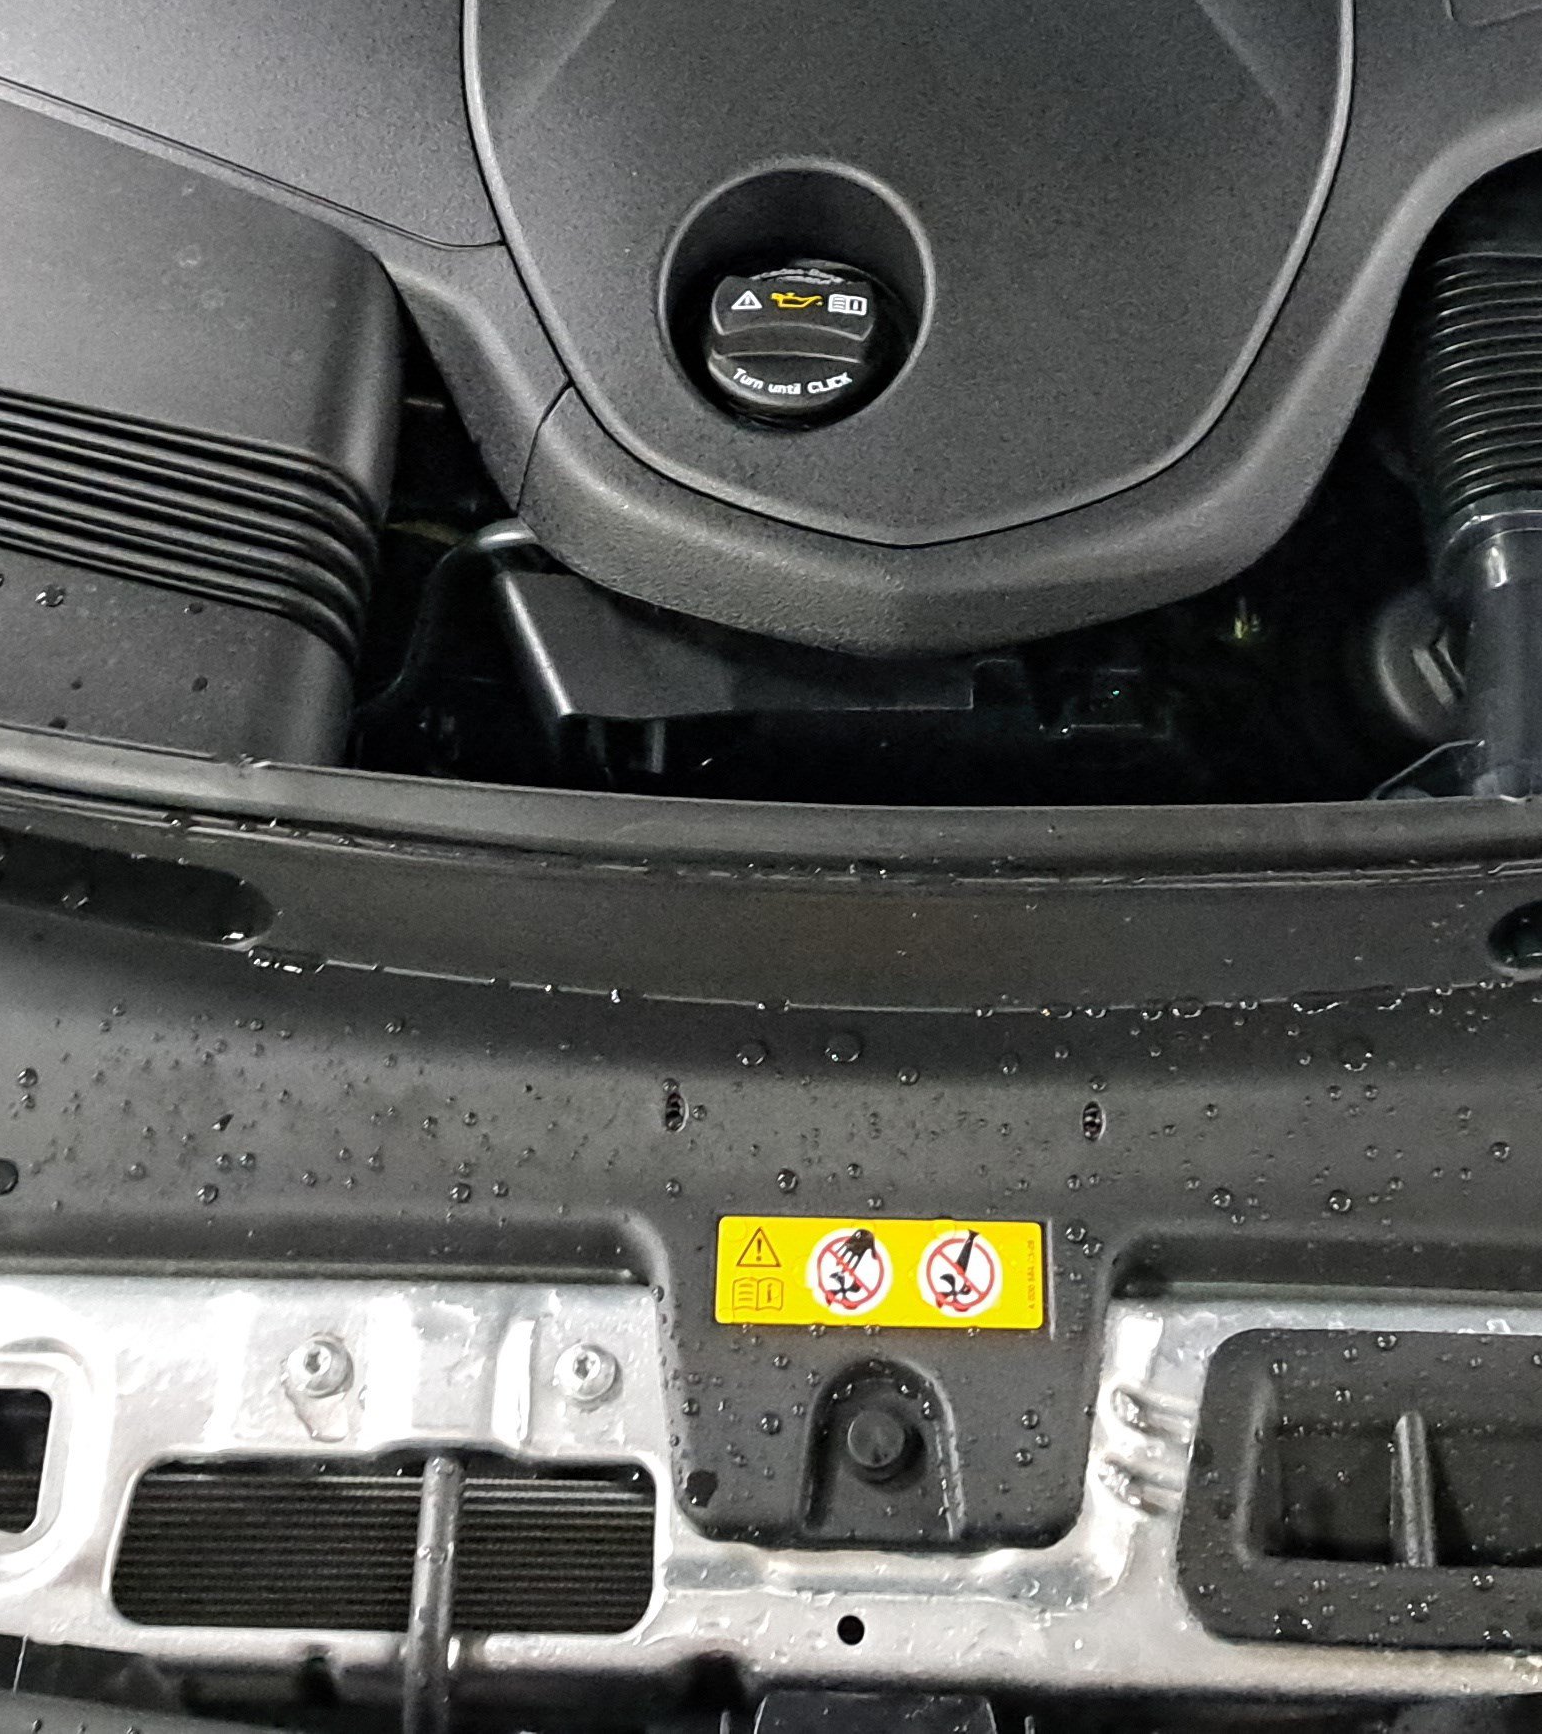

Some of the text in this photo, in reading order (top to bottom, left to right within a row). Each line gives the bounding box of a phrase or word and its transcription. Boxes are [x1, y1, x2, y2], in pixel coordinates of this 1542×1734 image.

[732, 367, 853, 395] Turn until CLICK
